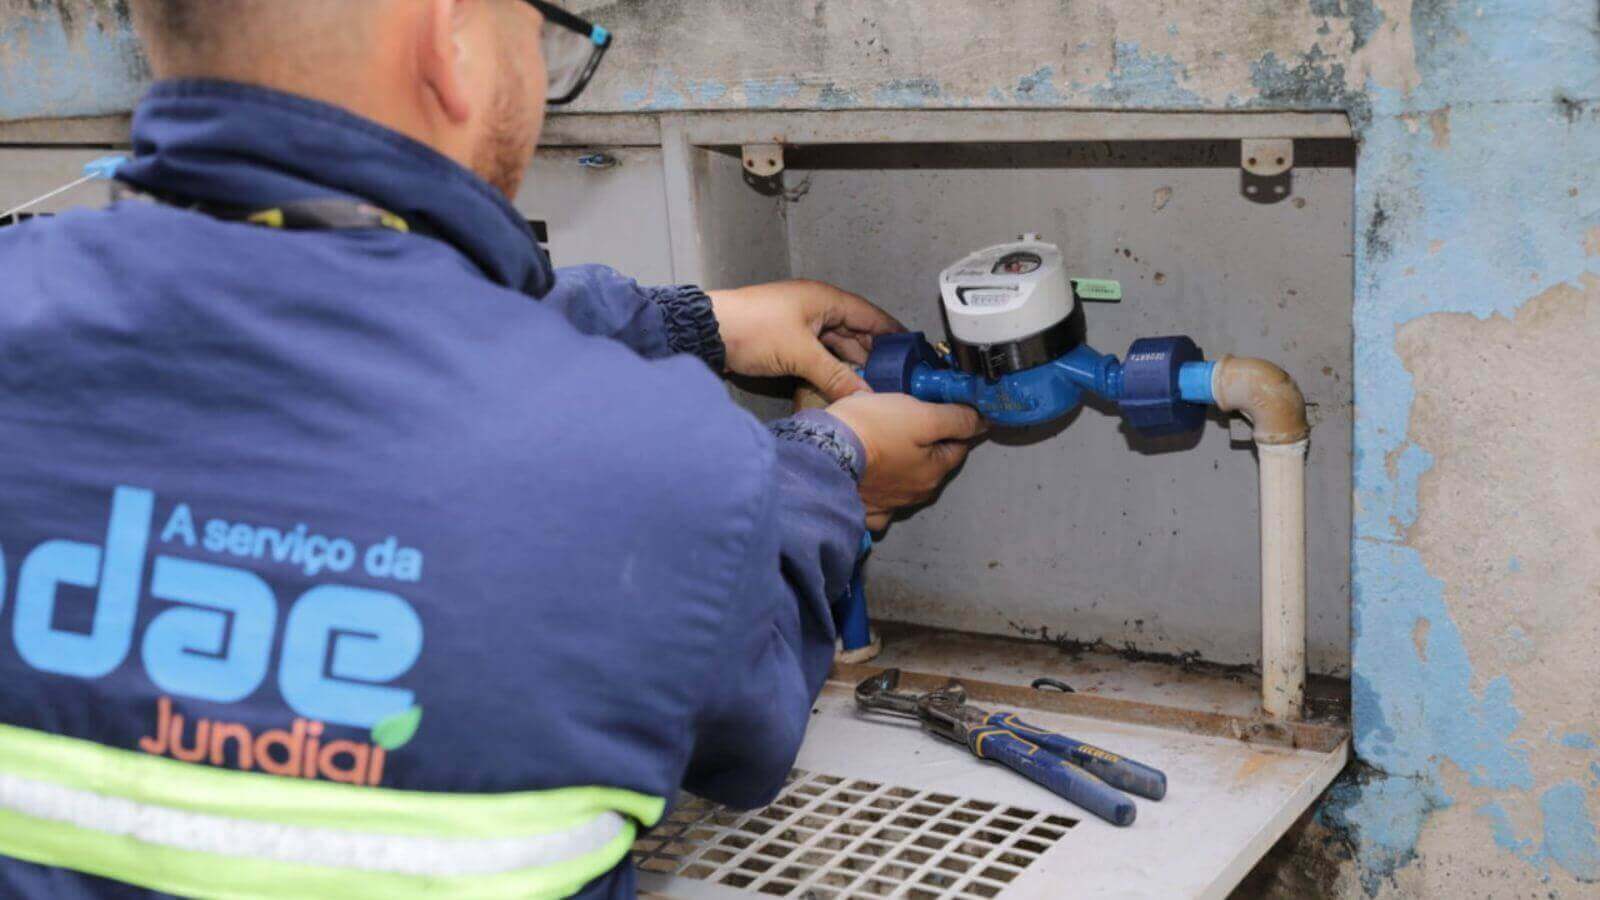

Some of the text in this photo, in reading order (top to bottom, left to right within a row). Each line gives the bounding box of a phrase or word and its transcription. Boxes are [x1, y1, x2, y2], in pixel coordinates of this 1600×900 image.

[161, 502, 424, 583] A serviço da
